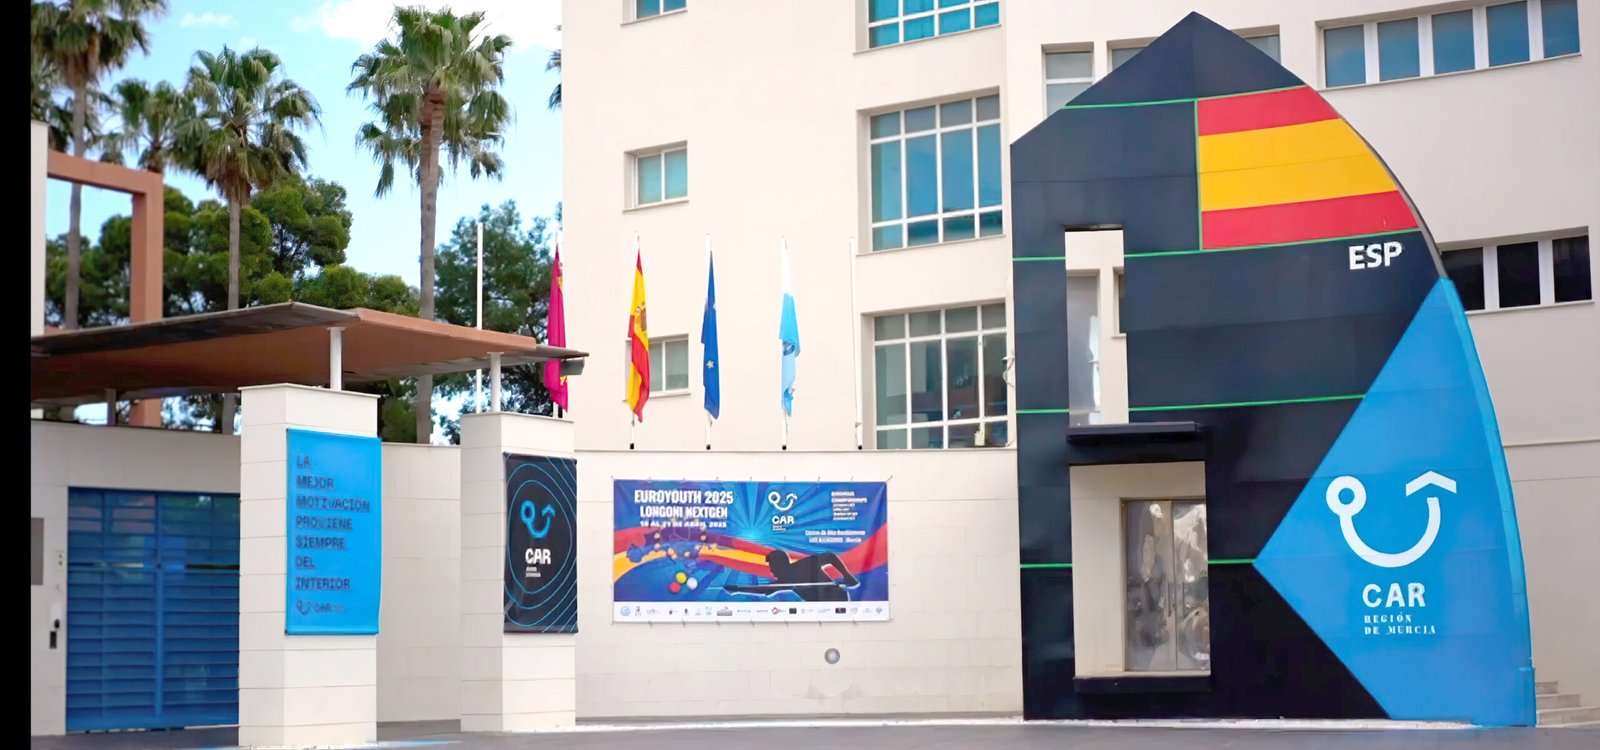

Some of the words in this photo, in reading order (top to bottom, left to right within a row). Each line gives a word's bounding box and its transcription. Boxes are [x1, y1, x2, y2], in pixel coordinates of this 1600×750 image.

[1348, 241, 1403, 270] ESP
[296, 455, 311, 468] LA
[296, 475, 334, 489] MEJOR
[295, 495, 370, 512] MOTIVACIÓN
[634, 489, 702, 504] EUROYOUTH
[704, 490, 734, 504] 2025
[639, 505, 683, 518] LONGONI
[685, 506, 728, 519] NEXTGEN
[295, 515, 352, 530] PROVIENE
[772, 515, 794, 524] CAR
[295, 535, 345, 549] SIEMPRE
[295, 556, 315, 569] DEL
[525, 547, 552, 565] CAR
[295, 576, 351, 590] INTERIOR
[1362, 582, 1426, 608] CAR
[1364, 611, 1412, 624] REGIÓN
[1364, 625, 1380, 635] DE
[1386, 624, 1436, 635] MURCIA
